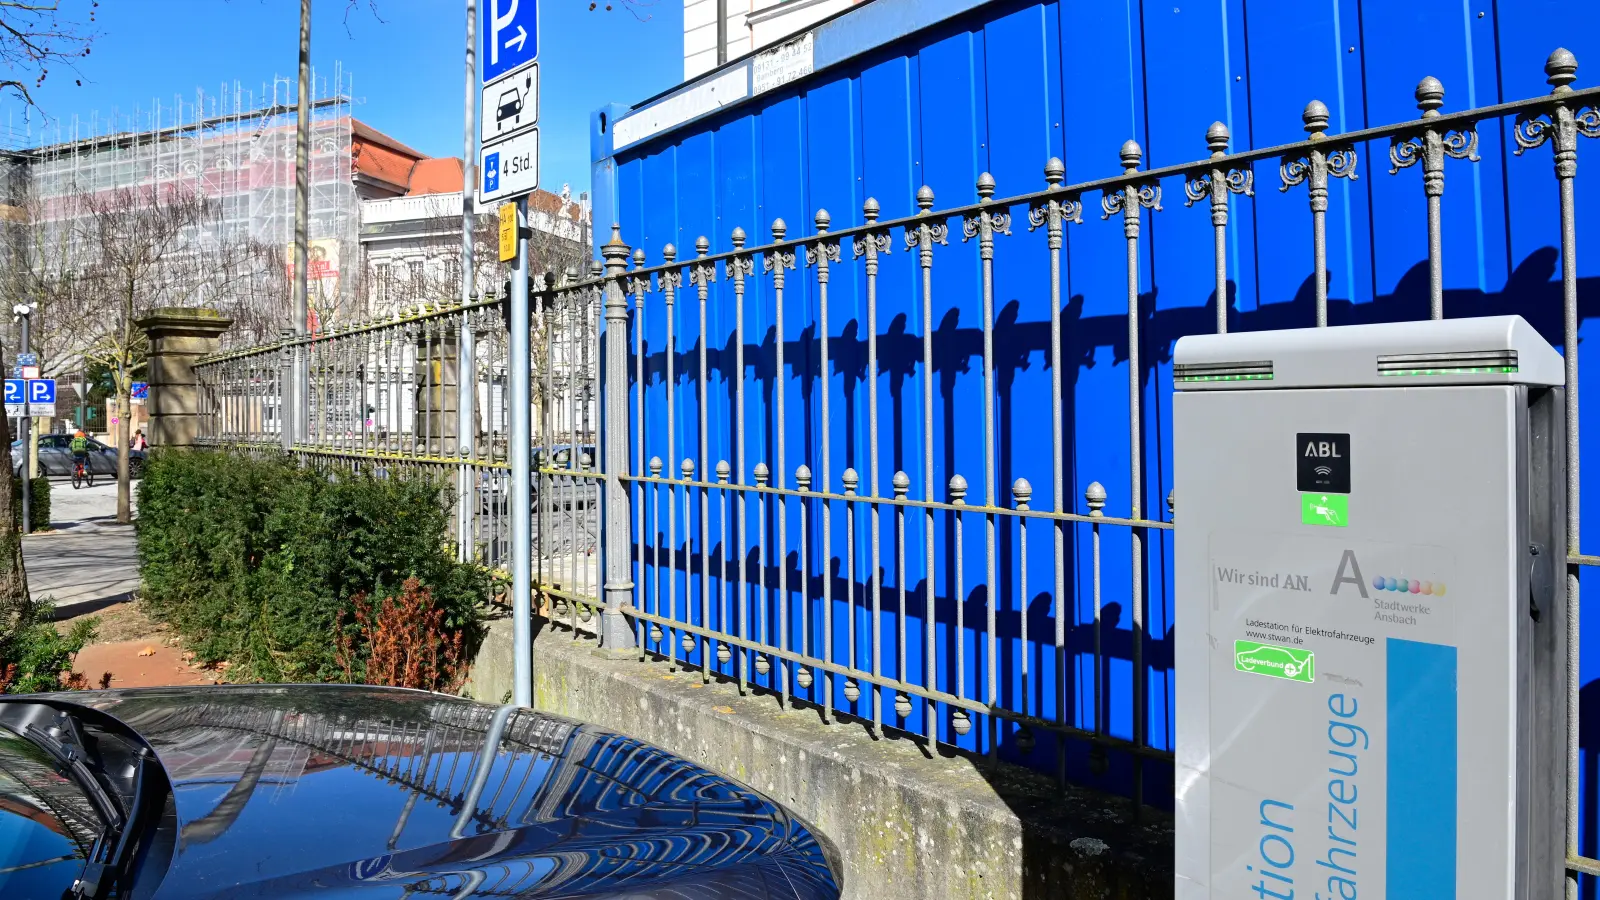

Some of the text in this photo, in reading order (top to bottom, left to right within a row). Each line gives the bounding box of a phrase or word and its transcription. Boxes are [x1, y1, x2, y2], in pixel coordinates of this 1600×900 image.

[490, 0, 520, 66] P
[756, 66, 784, 81] Bamberg
[503, 152, 533, 176] 4 Std.
[33, 382, 47, 400] P
[1304, 441, 1342, 458] ABL
[1218, 566, 1312, 592] Wir sind AN.
[1330, 549, 1369, 599] A
[1374, 598, 1431, 615] Stadtwerke
[1374, 611, 1417, 625] Ansbach
[1245, 618, 1375, 645] Ladestation für Elektrofahrzeuge
[1246, 630, 1304, 645] www.stwan.de
[1240, 655, 1284, 669] Ladeverbund
[1247, 799, 1294, 900] tion
